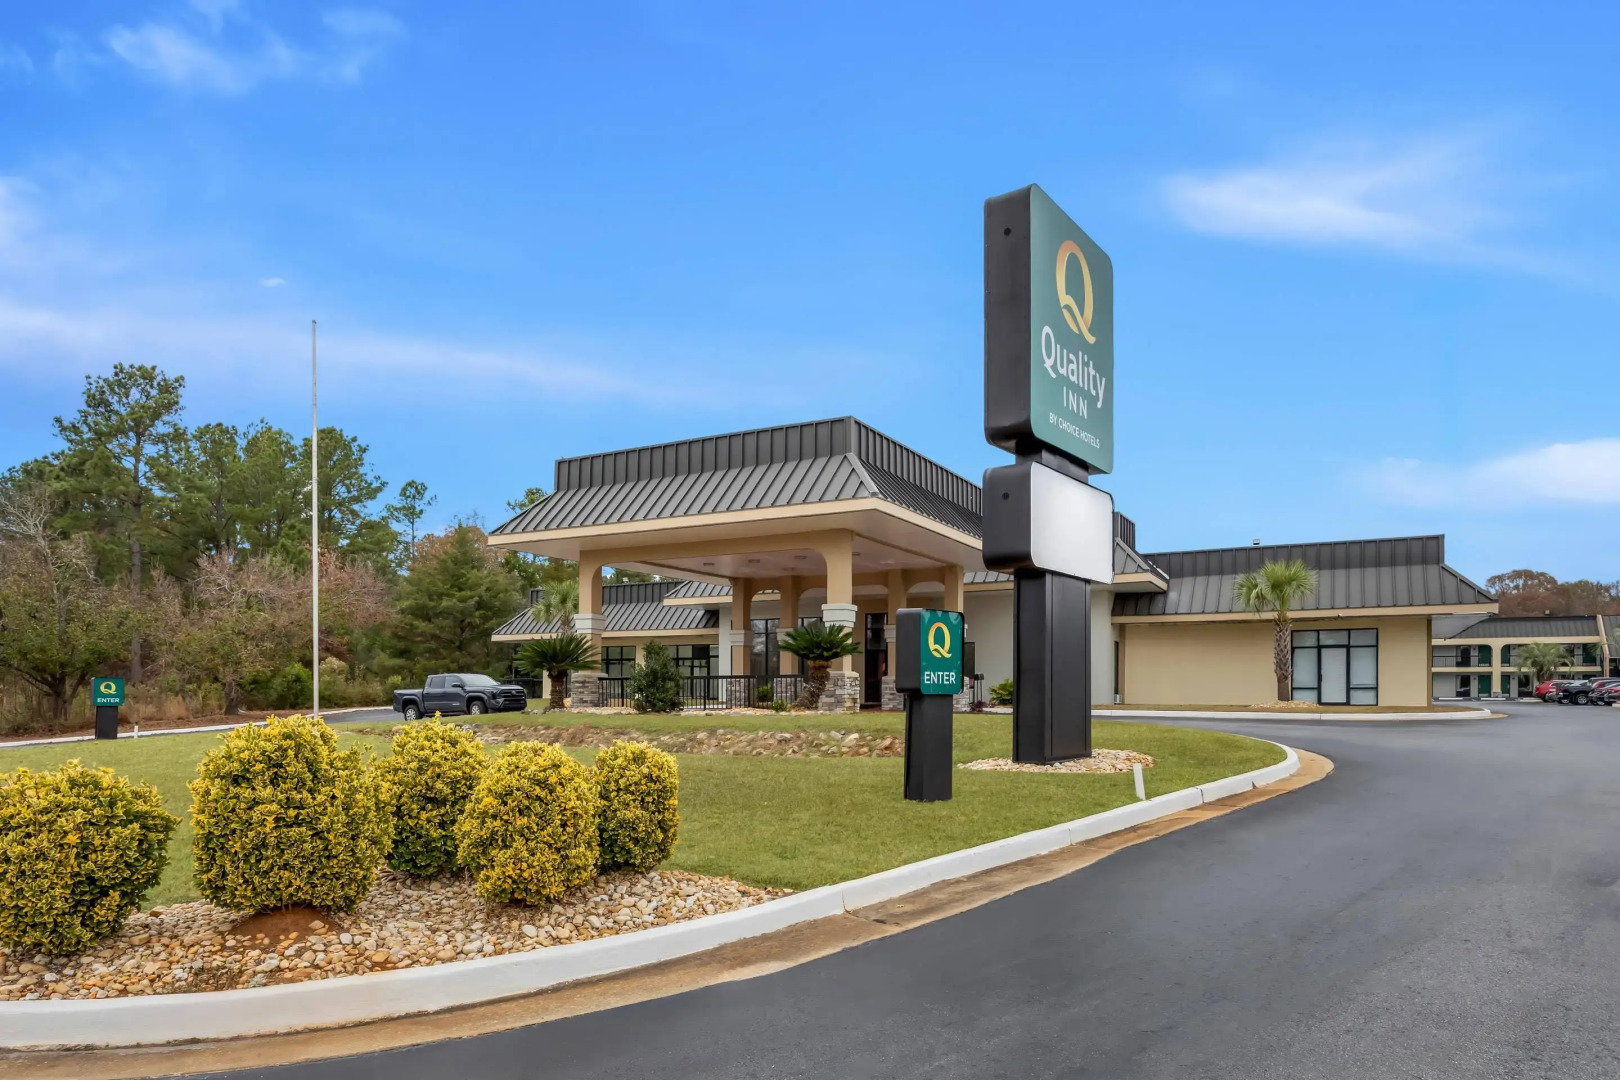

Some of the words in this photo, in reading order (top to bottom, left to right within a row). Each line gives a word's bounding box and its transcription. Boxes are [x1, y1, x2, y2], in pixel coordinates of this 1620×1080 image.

[1056, 240, 1096, 344] Q
[1041, 325, 1105, 408] Quality
[1063, 386, 1087, 419] INN
[1049, 412, 1058, 426] BY
[1058, 418, 1080, 438] CHOICE
[1080, 429, 1100, 449] HOTELS
[928, 622, 952, 658] Q
[100, 681, 117, 694] Q
[924, 671, 956, 684] ENTER
